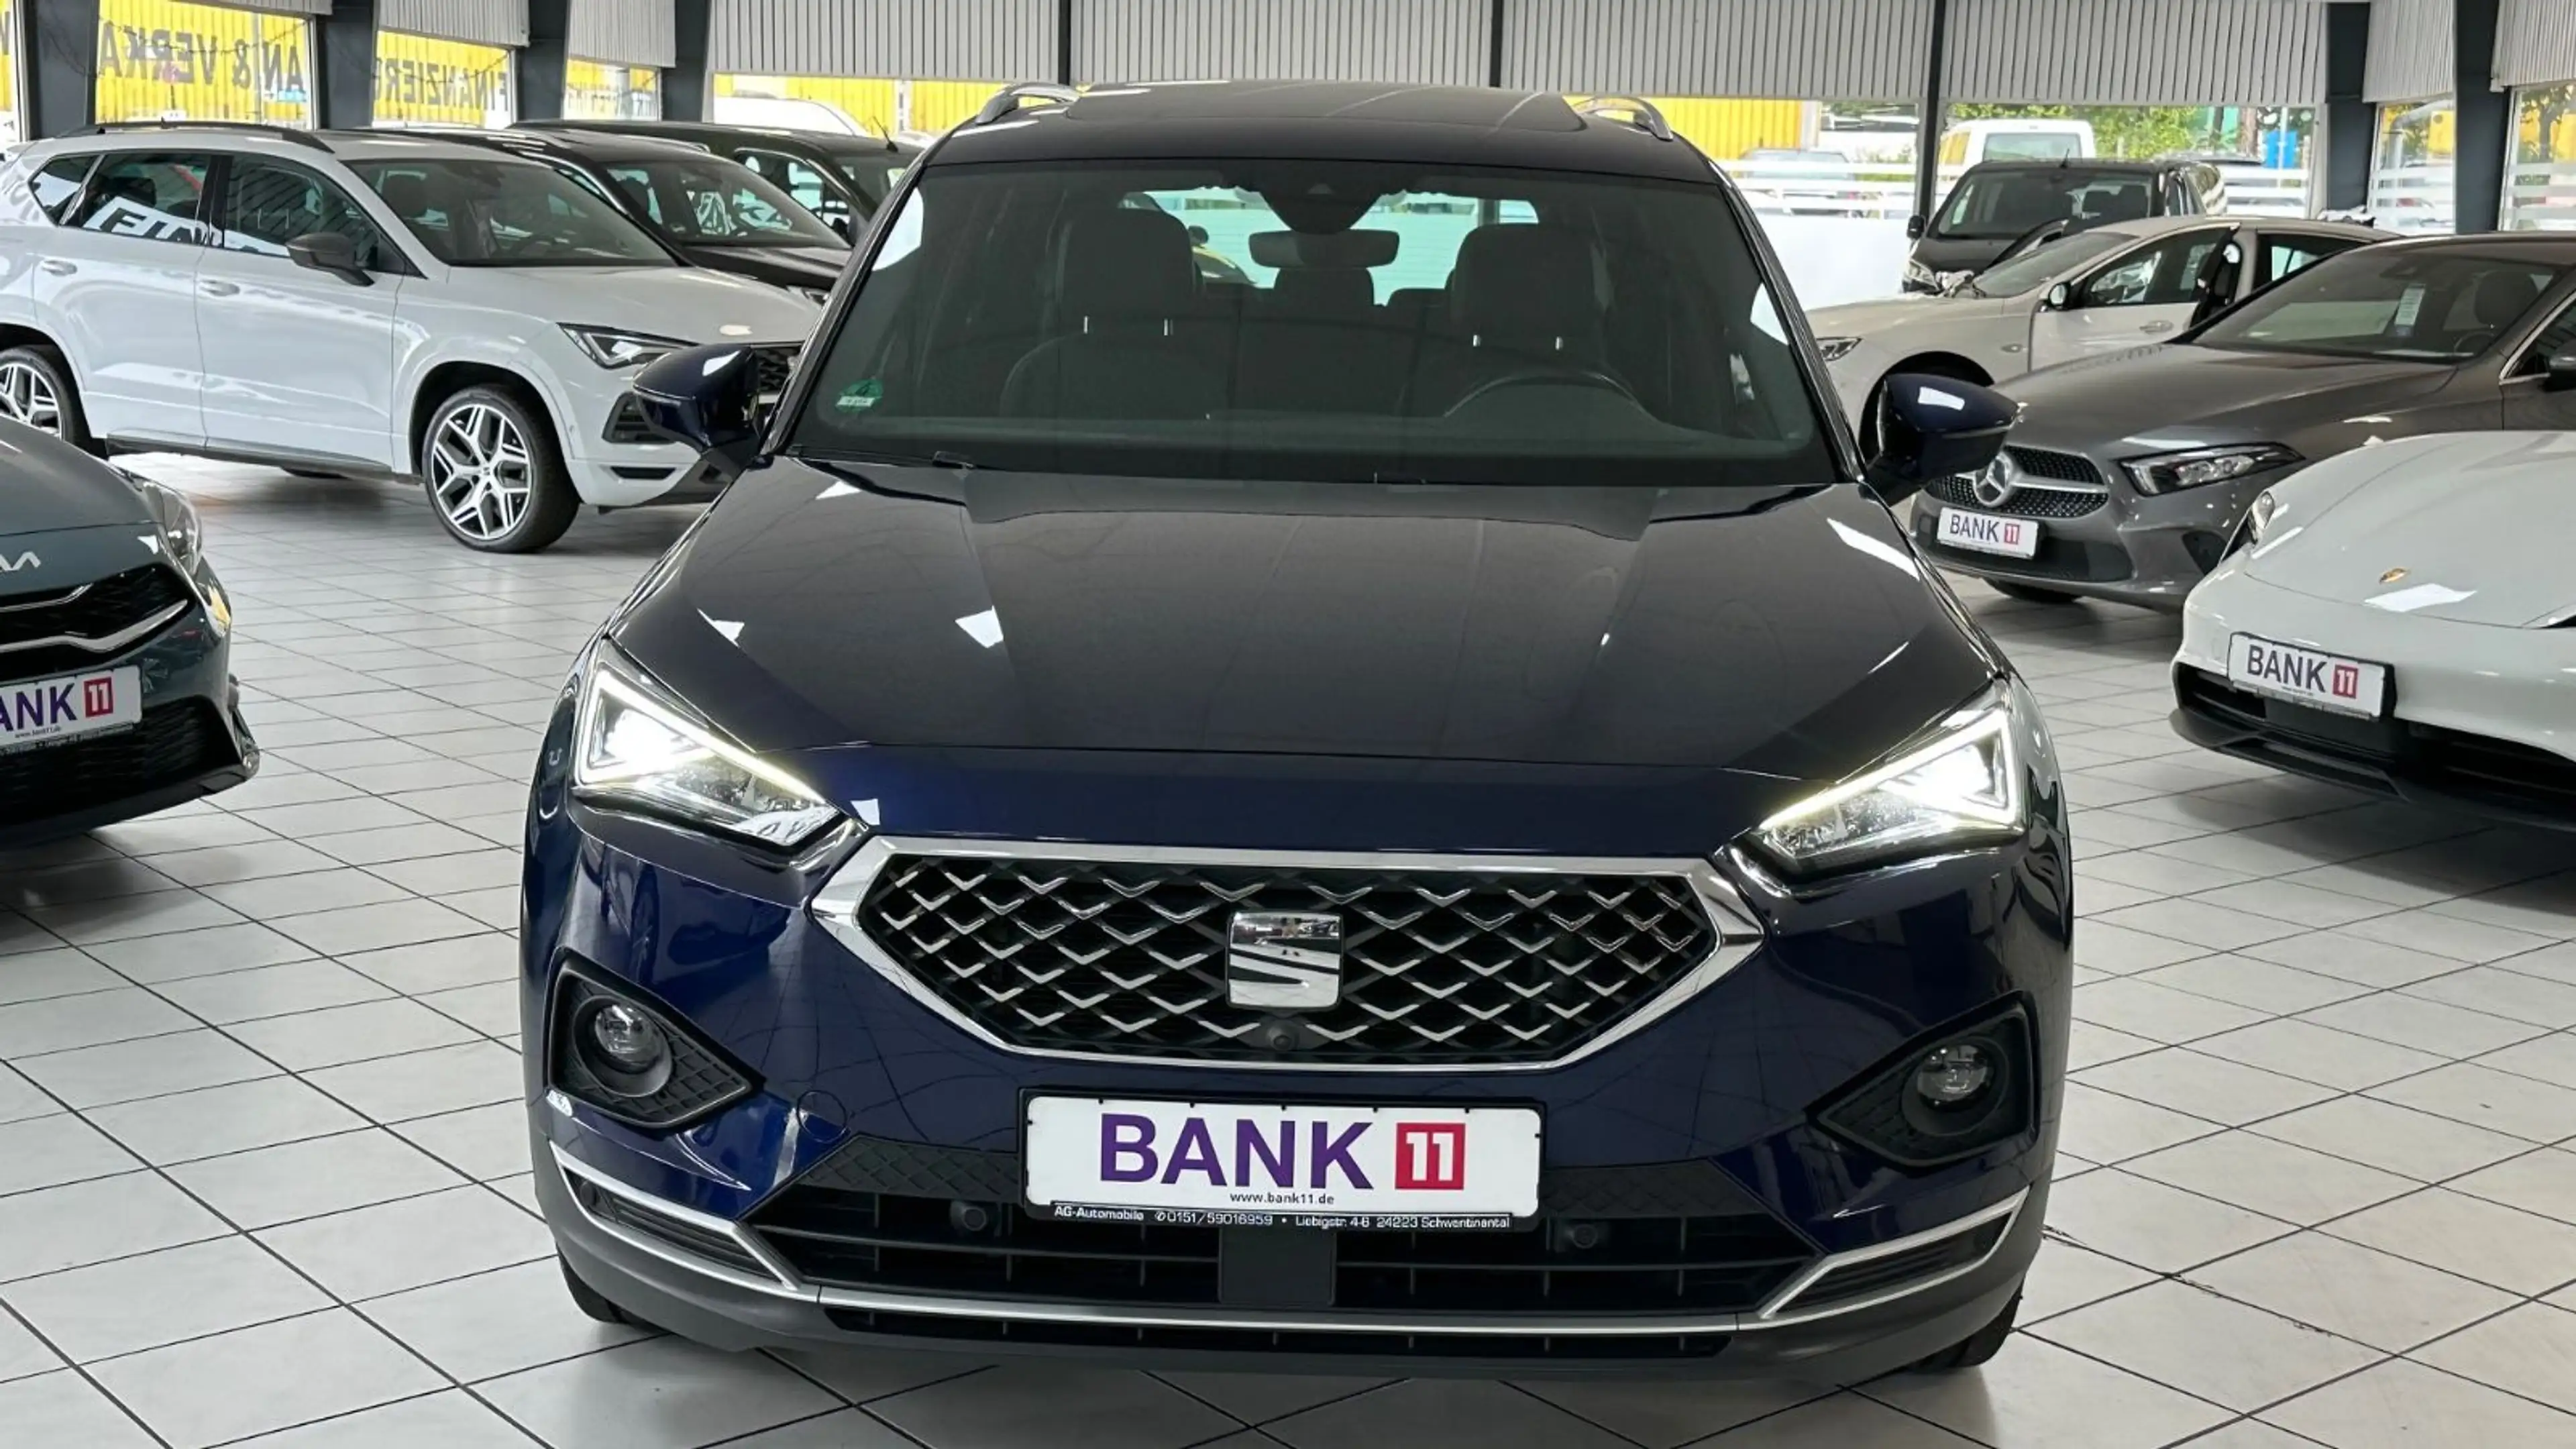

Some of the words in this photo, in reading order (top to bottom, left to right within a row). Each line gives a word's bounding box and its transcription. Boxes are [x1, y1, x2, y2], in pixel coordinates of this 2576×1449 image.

[1949, 513, 2000, 543] BANK
[2247, 644, 2327, 693] BANK
[2335, 667, 2356, 696] 11
[88, 681, 110, 713] 11
[1100, 1113, 1373, 1190] BANK
[1403, 1130, 1457, 1184] 11
[1230, 1191, 1335, 1205] www.bank11.de
